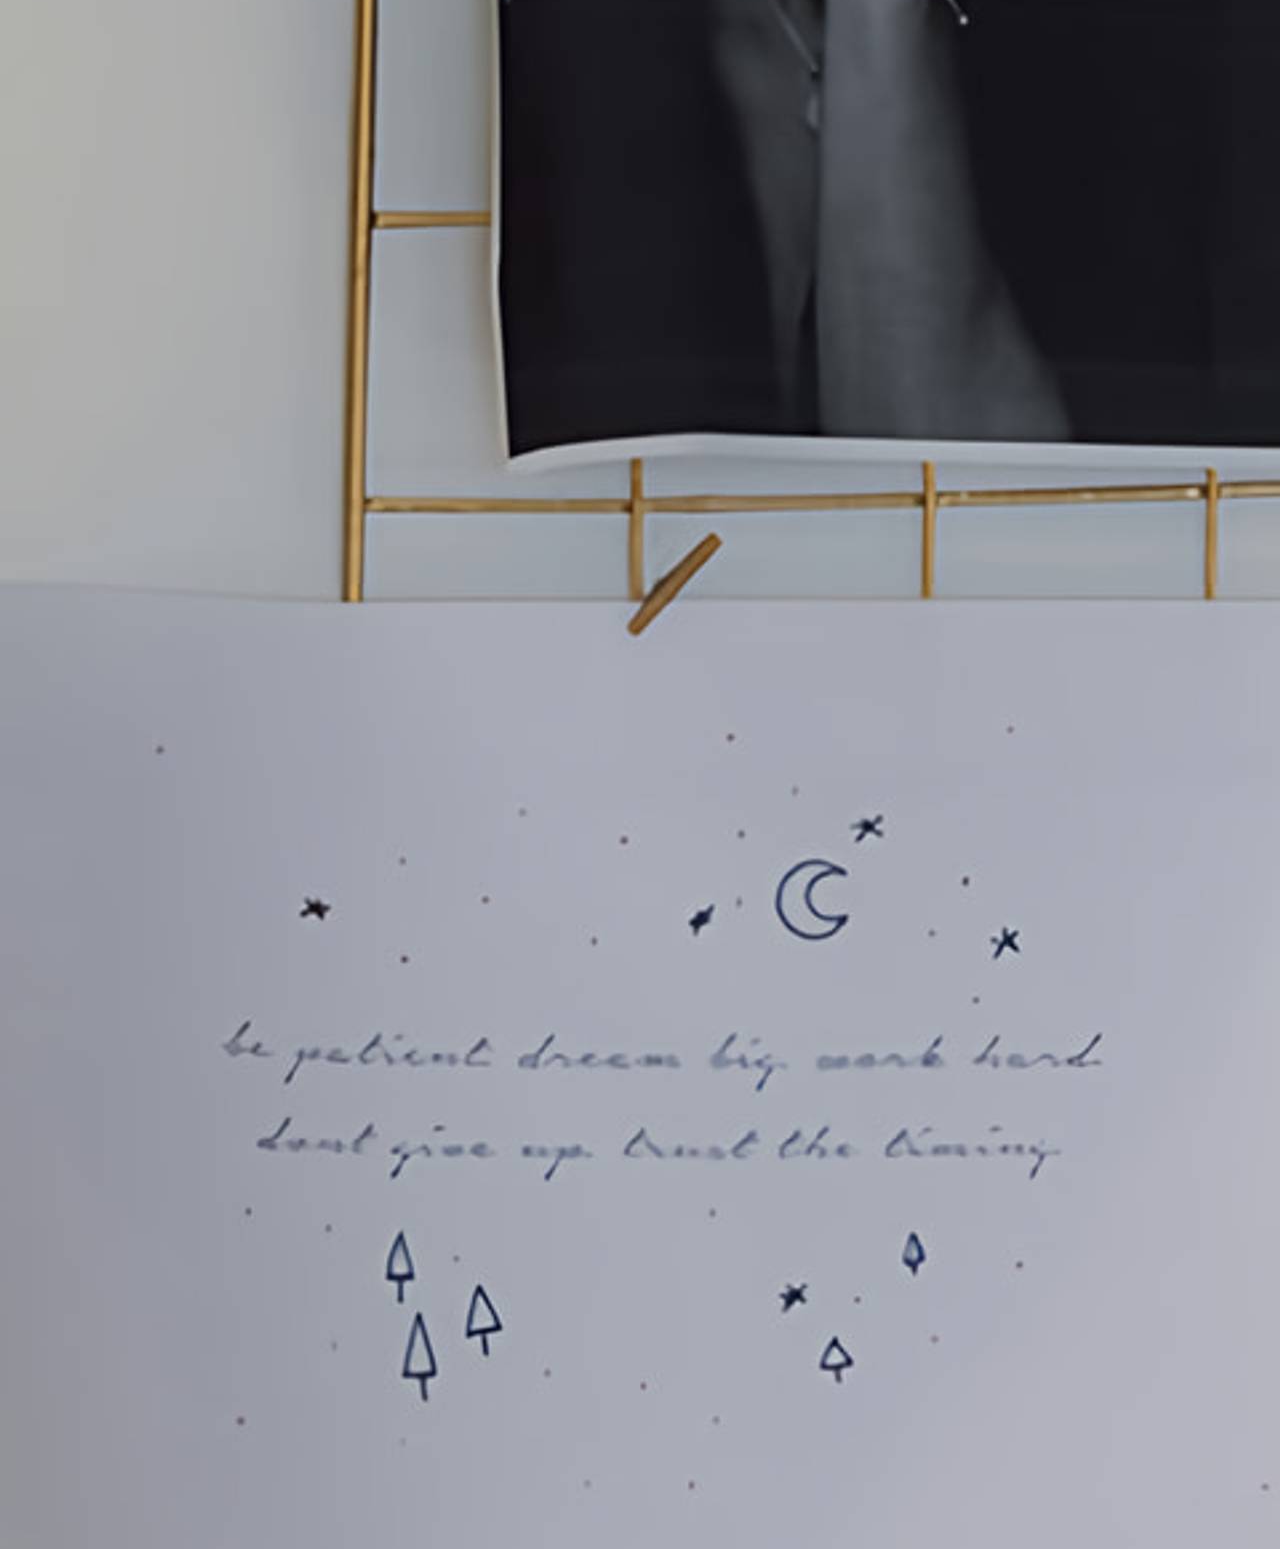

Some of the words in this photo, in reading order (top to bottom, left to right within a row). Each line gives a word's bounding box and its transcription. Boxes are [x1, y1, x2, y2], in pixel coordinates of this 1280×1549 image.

[221, 1020, 272, 1057] be
[283, 1033, 492, 1084] patient
[517, 1033, 681, 1069] dream
[816, 1035, 944, 1070] work
[973, 1033, 1103, 1068] hard
[389, 1124, 495, 1178] give
[623, 1128, 758, 1159] trust
[778, 1126, 852, 1159] the
[884, 1125, 1062, 1179] timing
